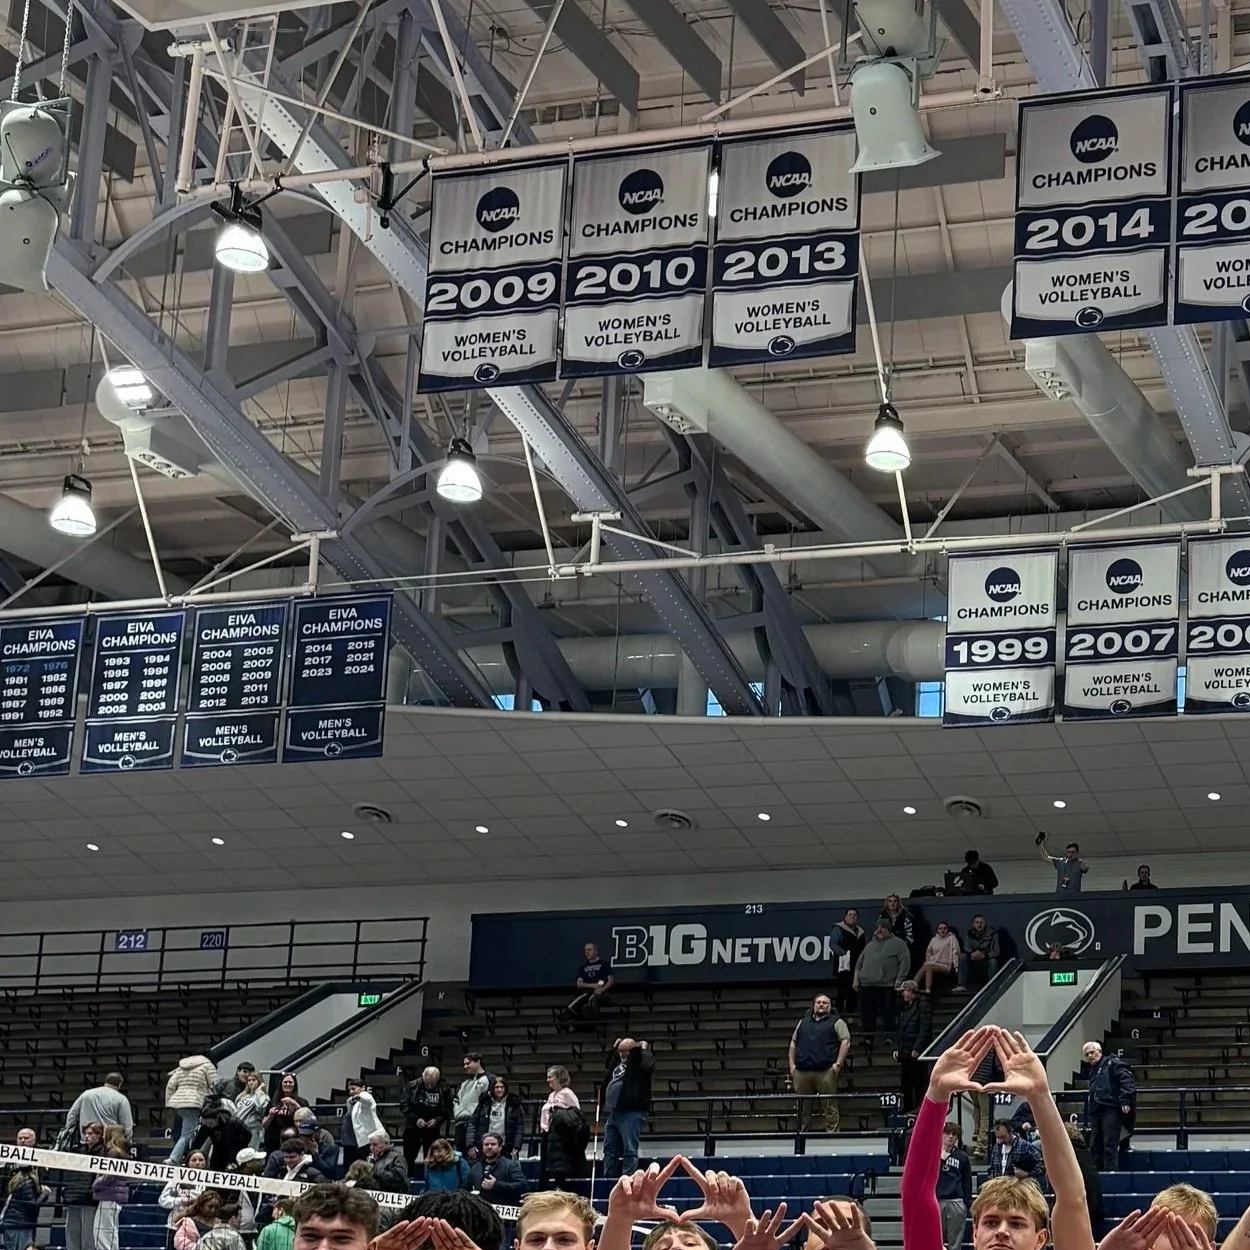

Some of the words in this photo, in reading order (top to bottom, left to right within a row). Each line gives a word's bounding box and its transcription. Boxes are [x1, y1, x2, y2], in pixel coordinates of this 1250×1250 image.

[1076, 136, 1118, 153] NCAA
[770, 171, 810, 188] NCAA
[1032, 163, 1157, 189] CHAMPIONS
[622, 188, 662, 205] NCAA
[480, 205, 520, 222] NCAA
[730, 198, 848, 223] CHAMPIONS
[581, 213, 699, 238] CHAMPIONS
[1025, 208, 1154, 249] 2014
[440, 230, 554, 255] CHAMPIONS
[723, 241, 846, 280] 2013
[575, 257, 695, 296] 2010
[1051, 270, 1130, 287] WOMEN'S
[427, 273, 556, 311] 2009
[1039, 285, 1141, 305] VOLLEYBALL
[746, 300, 820, 318] WOMEN'S
[599, 313, 671, 331] WOMEN'S
[734, 314, 831, 334] VOLLEYBALL
[455, 329, 527, 346] WOMEN'S
[584, 328, 681, 347] VOLLEYBALL
[441, 343, 536, 362] VOLLEYBALL
[1110, 574, 1142, 586] NCAA
[988, 584, 1021, 594] NCAA
[1077, 594, 1172, 611] CHAMPIONS
[328, 607, 358, 620] EIVA
[957, 604, 1049, 619] CHAMPIONS
[127, 622, 154, 634] EIVA
[228, 614, 256, 627] EIVA
[302, 618, 383, 634] CHAMPIONS
[28, 629, 54, 641] EIVA
[102, 632, 177, 647] CHAMPIONS
[201, 624, 280, 640] CHAMPIONS
[3, 640, 76, 655] CHAMPIONS
[305, 643, 333, 653] 2014
[347, 640, 375, 650] 2015
[953, 636, 1048, 664] 1999
[1069, 628, 1176, 657] 2007
[202, 649, 232, 659] 2004
[243, 646, 274, 656] 2005
[304, 655, 331, 665] 2017
[346, 652, 374, 662] 2021
[201, 661, 231, 671] 2006
[242, 658, 273, 668] 2007
[302, 667, 333, 677] 2023
[344, 664, 375, 674] 2024
[200, 673, 230, 683] 2008
[241, 671, 272, 681] 2009
[1092, 672, 1152, 685] WOMEN'S
[200, 685, 228, 695] 2010
[243, 683, 268, 693] 2011
[972, 681, 1031, 692] WOMEN'S
[1082, 683, 1161, 698] VOLLEYBALL
[199, 698, 226, 708] 2012
[240, 695, 268, 705] 2013
[963, 692, 1039, 704] VOLLEYBALL
[215, 724, 247, 736] MEN'S
[318, 718, 352, 730] MEN'S
[114, 730, 146, 743] MEN'S
[199, 734, 263, 747] VOLLEYBALL
[301, 727, 367, 741] VOLLEYBALL
[14, 737, 44, 748] MEN'S
[98, 740, 159, 753] VOLLEYBALL
[744, 904, 763, 914] 213
[119, 934, 145, 949] 212
[202, 934, 223, 947] 220
[1053, 972, 1075, 984] EXIT
[880, 1096, 896, 1105] 113
[995, 1094, 1011, 1103] 114
[90, 1157, 129, 1176] PENN
[133, 1162, 174, 1179] STATE
[179, 1168, 260, 1189] VOLLEYBALL
